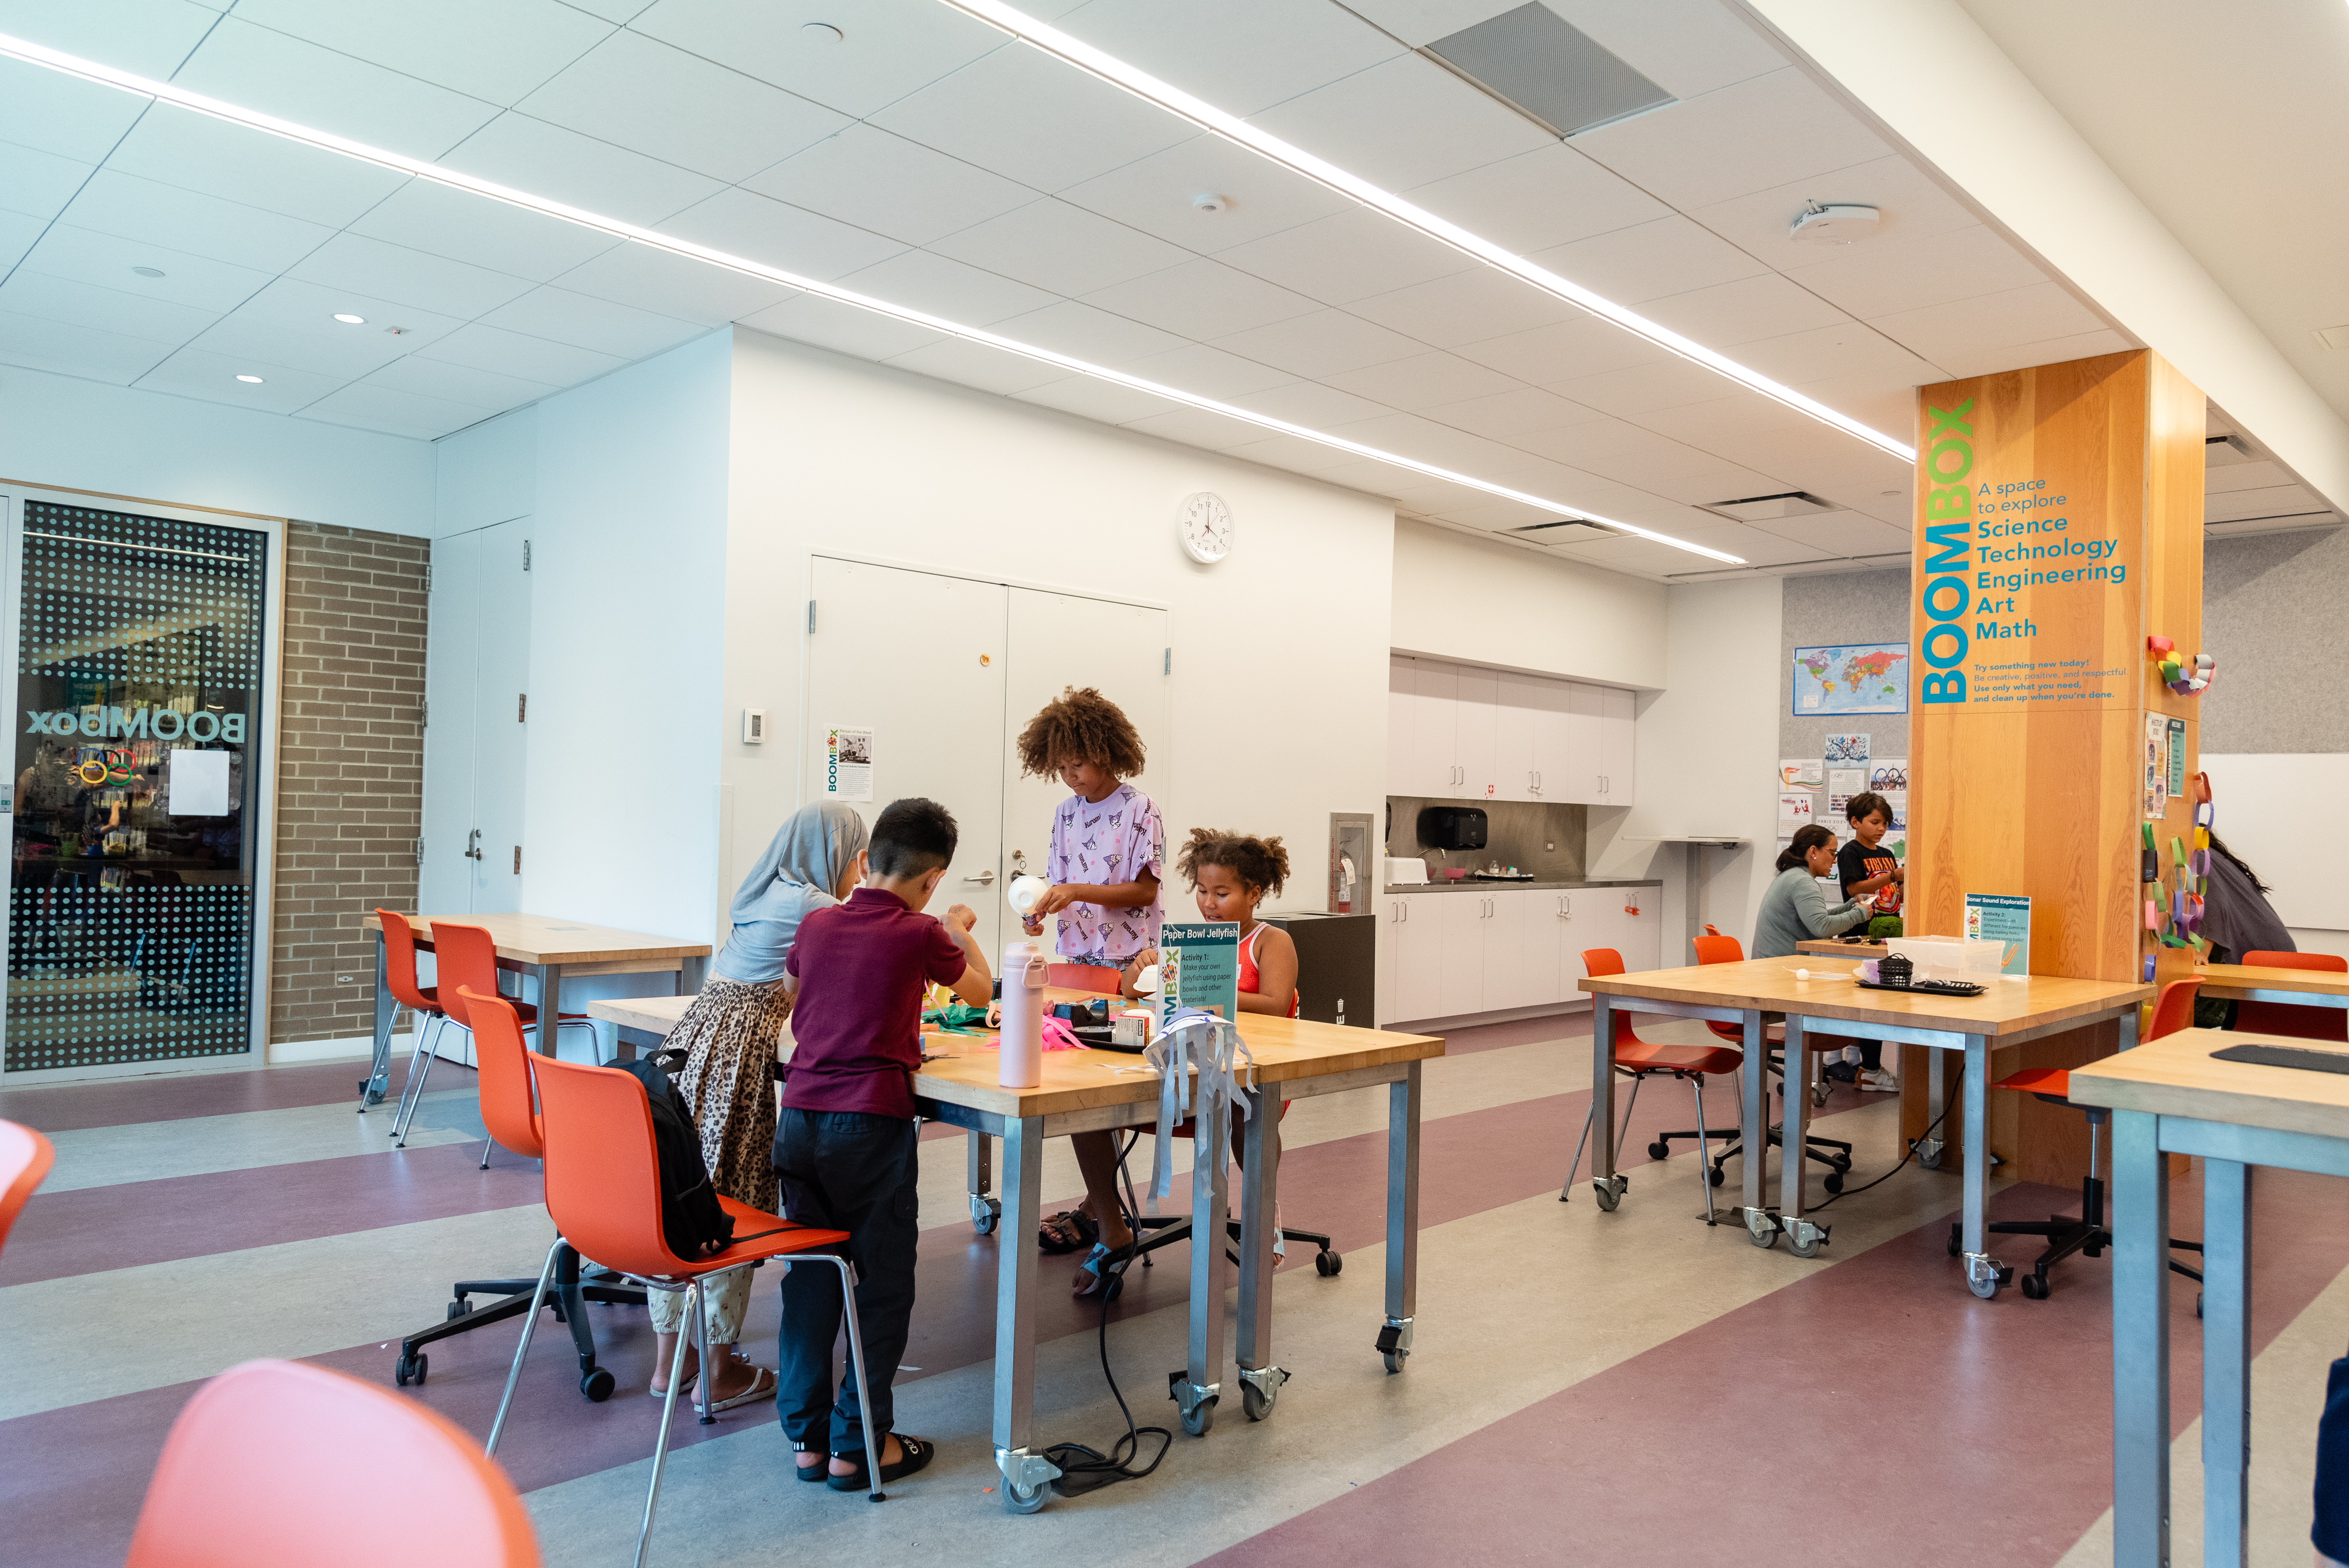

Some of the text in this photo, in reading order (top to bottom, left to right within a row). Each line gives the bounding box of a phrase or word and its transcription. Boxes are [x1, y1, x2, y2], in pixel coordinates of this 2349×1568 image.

[1978, 479, 2046, 498] A space
[1978, 494, 2067, 514] to explore
[1978, 517, 2068, 539] Science
[1922, 397, 1973, 704] BOOMBOX
[1977, 537, 2118, 564] Technology
[1978, 562, 2126, 592] Engineering
[1976, 597, 2015, 615] Art
[1976, 619, 2036, 640] Math
[1974, 664, 1987, 672] Try
[2059, 659, 2089, 668] today!
[2025, 672, 2060, 681] positive,
[2082, 668, 2128, 678] respectful.
[1992, 684, 2010, 692] only
[2057, 681, 2081, 689] need,
[1084, 813, 1101, 829] Kuromi
[1078, 853, 1089, 873] Kuromi
[1121, 921, 1139, 941] Kuromi
[1163, 927, 1238, 941] Paper Bowl Jellyfish
[1181, 954, 1203, 962] Activity
[1182, 974, 1202, 983] jellyfish
